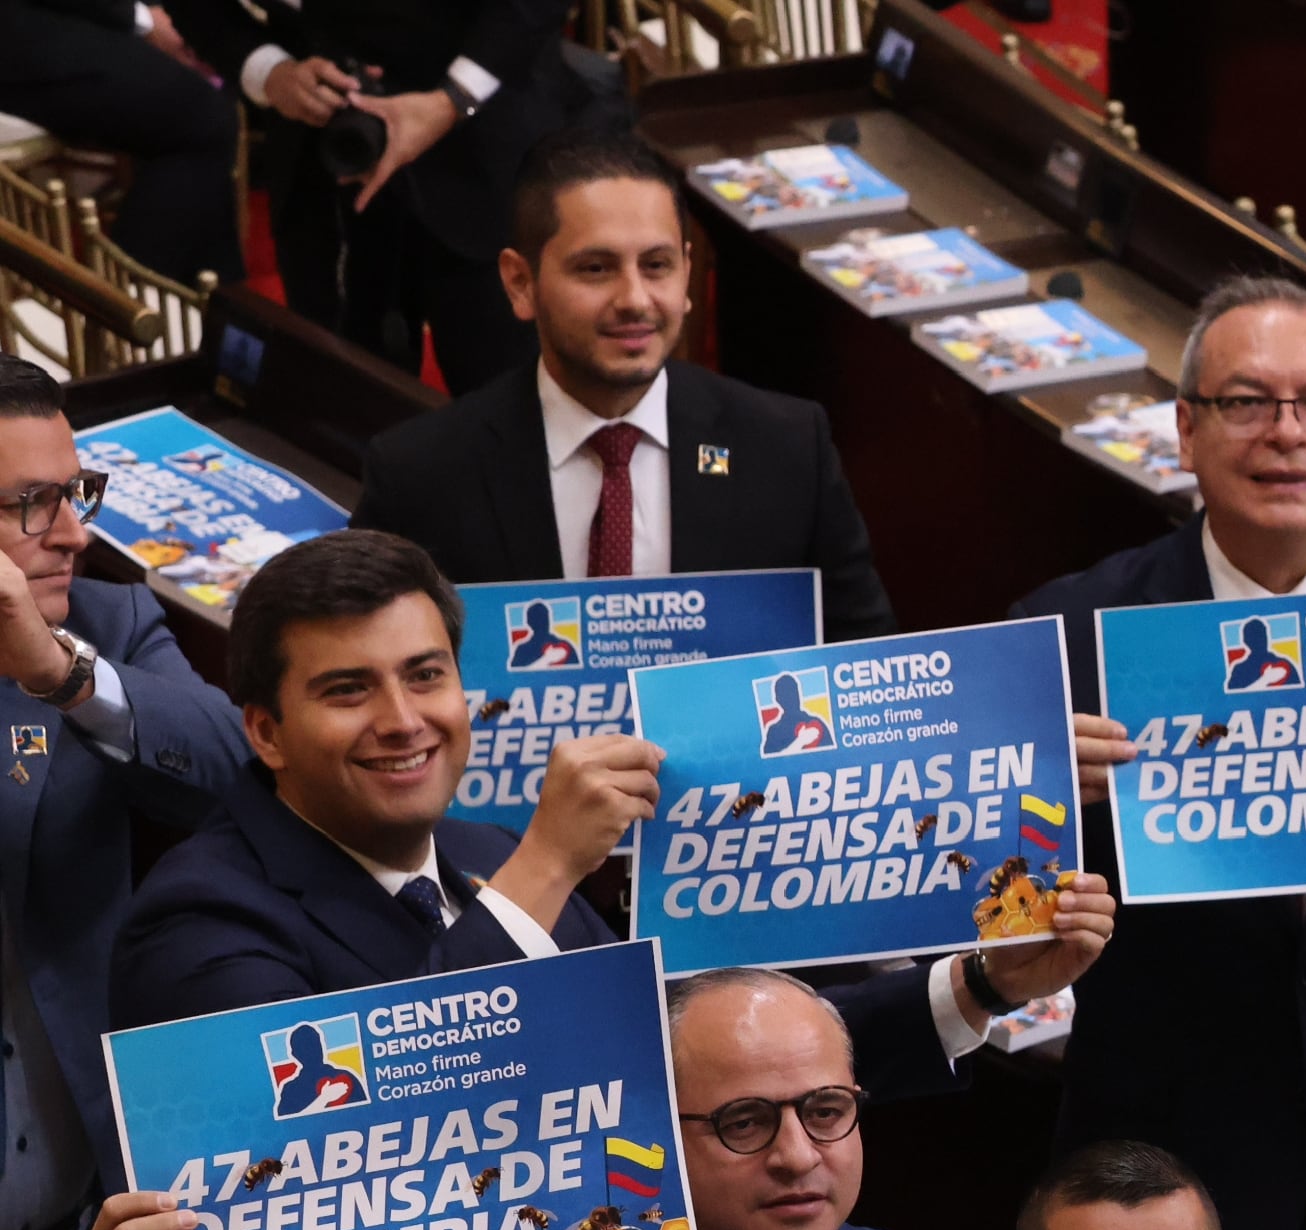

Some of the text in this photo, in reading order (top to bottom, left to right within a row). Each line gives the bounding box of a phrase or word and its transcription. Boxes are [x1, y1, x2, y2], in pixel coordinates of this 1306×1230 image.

[586, 590, 705, 618] CENTRO
[588, 616, 706, 635] DEMOCRÁTICO
[588, 636, 672, 652] Mano firme
[589, 652, 652, 668] Corazón
[833, 651, 951, 690] CENTRO
[463, 683, 634, 726] 7 ABEJ
[837, 680, 953, 709] DEMOCRÁTICO
[840, 707, 922, 729] Mano firme
[842, 720, 958, 748] Corazón grande
[1134, 714, 1202, 758] 47
[666, 743, 1035, 828] 47 ABEJAS EN
[662, 795, 1002, 875] DEFENSA DE
[662, 850, 962, 918] COLOMBIA
[366, 985, 517, 1037] CENTRO
[372, 1018, 521, 1058] DEMOCRÁTICO
[375, 1050, 481, 1082] Mano firme
[377, 1060, 527, 1101] Corazón grande
[172, 1080, 623, 1206] 47 ABEJAS EN
[500, 1141, 582, 1201] DE
